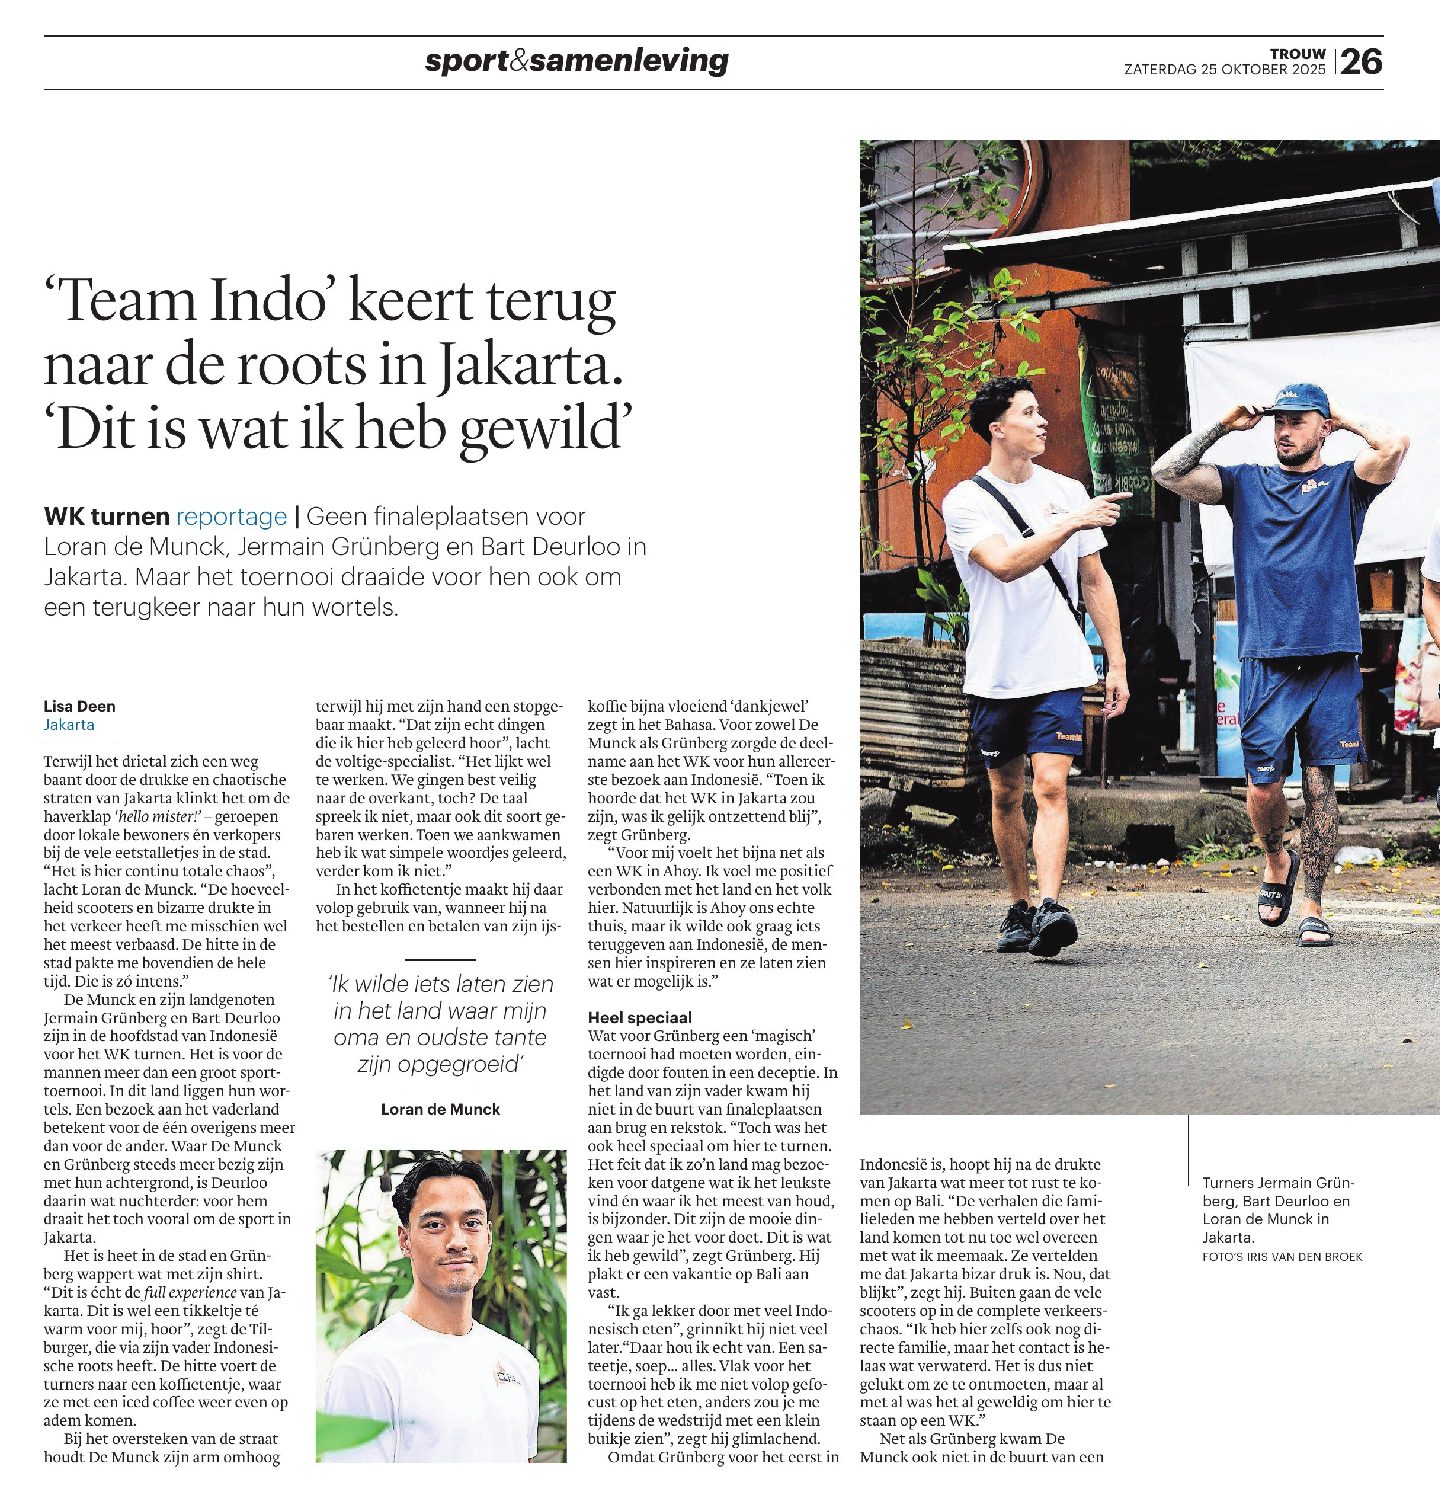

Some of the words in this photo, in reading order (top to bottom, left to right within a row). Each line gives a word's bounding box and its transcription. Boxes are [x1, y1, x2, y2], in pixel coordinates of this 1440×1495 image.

[424, 46, 730, 78] sport&samenleving
[1269, 48, 1327, 60] TROUW
[1340, 47, 1383, 75] 26
[1124, 63, 1197, 75] ZATERDAG
[1201, 63, 1217, 75] 25
[1221, 63, 1288, 75] OKTOBER
[1292, 63, 1326, 75] 2025
[348, 273, 474, 322] keert
[485, 282, 617, 336] terug
[43, 353, 154, 386] naar
[165, 337, 226, 386] de
[237, 346, 367, 386] roots
[378, 340, 427, 385] in
[435, 337, 623, 398] Jakarta.
[147, 404, 186, 450] is
[197, 410, 289, 450] wat
[299, 401, 345, 449] ik
[354, 401, 447, 450] heb
[43, 506, 86, 526] WK
[90, 508, 170, 526] turnen
[177, 508, 287, 531] reportage
[306, 506, 367, 526] Geen
[373, 504, 528, 530] finaleplaatsen
[536, 511, 586, 526] voor
[45, 536, 106, 556] Loran
[114, 534, 143, 556] de
[150, 534, 230, 559] Munck,
[237, 536, 324, 556] Jermain
[331, 535, 439, 561] Grünberg
[446, 541, 473, 556] en
[482, 536, 526, 556] Bart
[533, 534, 621, 556] Deurloo
[628, 536, 646, 556] in
[43, 565, 128, 586] Jakarta.
[136, 567, 191, 586] Maar
[197, 565, 234, 586] het
[240, 568, 333, 586] toernooi
[341, 565, 425, 586] draaide
[431, 571, 482, 586] voor
[489, 565, 530, 586] hen
[538, 565, 579, 587] ook
[585, 571, 621, 586] om
[44, 601, 85, 617] een
[92, 596, 201, 621] terugkeer
[208, 601, 256, 617] naar
[263, 596, 304, 617] hun
[311, 596, 399, 617] wortels.
[43, 699, 73, 713] Lisa
[77, 699, 116, 713] Deen
[43, 717, 95, 731] Jakarta
[43, 754, 93, 772] Terwijl
[95, 754, 119, 768] het
[122, 754, 167, 768] drietal
[170, 754, 199, 768] zich
[202, 757, 229, 768] een
[231, 757, 259, 772] weg
[355, 973, 409, 993] wilde
[414, 975, 451, 993] iets
[456, 973, 506, 993] laten
[511, 978, 554, 993] zien
[334, 1001, 352, 1020] in
[358, 1000, 391, 1020] het
[397, 1000, 442, 1020] land
[448, 1005, 498, 1020] waar
[503, 1001, 547, 1024] mijn
[588, 1010, 624, 1024] Heel
[627, 1010, 692, 1027] speciaal
[333, 1032, 379, 1046] oma
[385, 1032, 411, 1046] en
[417, 1026, 489, 1046] oudste
[494, 1029, 547, 1046] tante
[356, 1054, 391, 1077] zijn
[381, 1102, 423, 1116] Loran
[427, 1102, 447, 1116] de
[450, 1102, 501, 1116] Munck
[1202, 1176, 1254, 1189] Turners
[1257, 1176, 1312, 1189] Jermain
[1316, 1176, 1355, 1189] Grün-
[1203, 1194, 1239, 1210] berg,
[1243, 1195, 1271, 1207] Bart
[1275, 1194, 1329, 1207] Deurloo
[1333, 1198, 1350, 1207] en
[1203, 1212, 1242, 1225] Loran
[1245, 1212, 1264, 1225] de
[1267, 1212, 1313, 1225] Munck
[1317, 1212, 1329, 1225] in
[1202, 1230, 1255, 1244] Jakarta.
[1247, 1252, 1268, 1262] IRIS
[1271, 1252, 1295, 1262] VAN
[1298, 1252, 1322, 1262] DEN
[1325, 1252, 1363, 1262] BROEK
[43, 1450, 85, 1463] houdt
[89, 1451, 108, 1463] De
[111, 1450, 160, 1463] Munck
[163, 1450, 189, 1468] zijn
[192, 1453, 220, 1463] arm
[223, 1450, 281, 1468] omhoog
